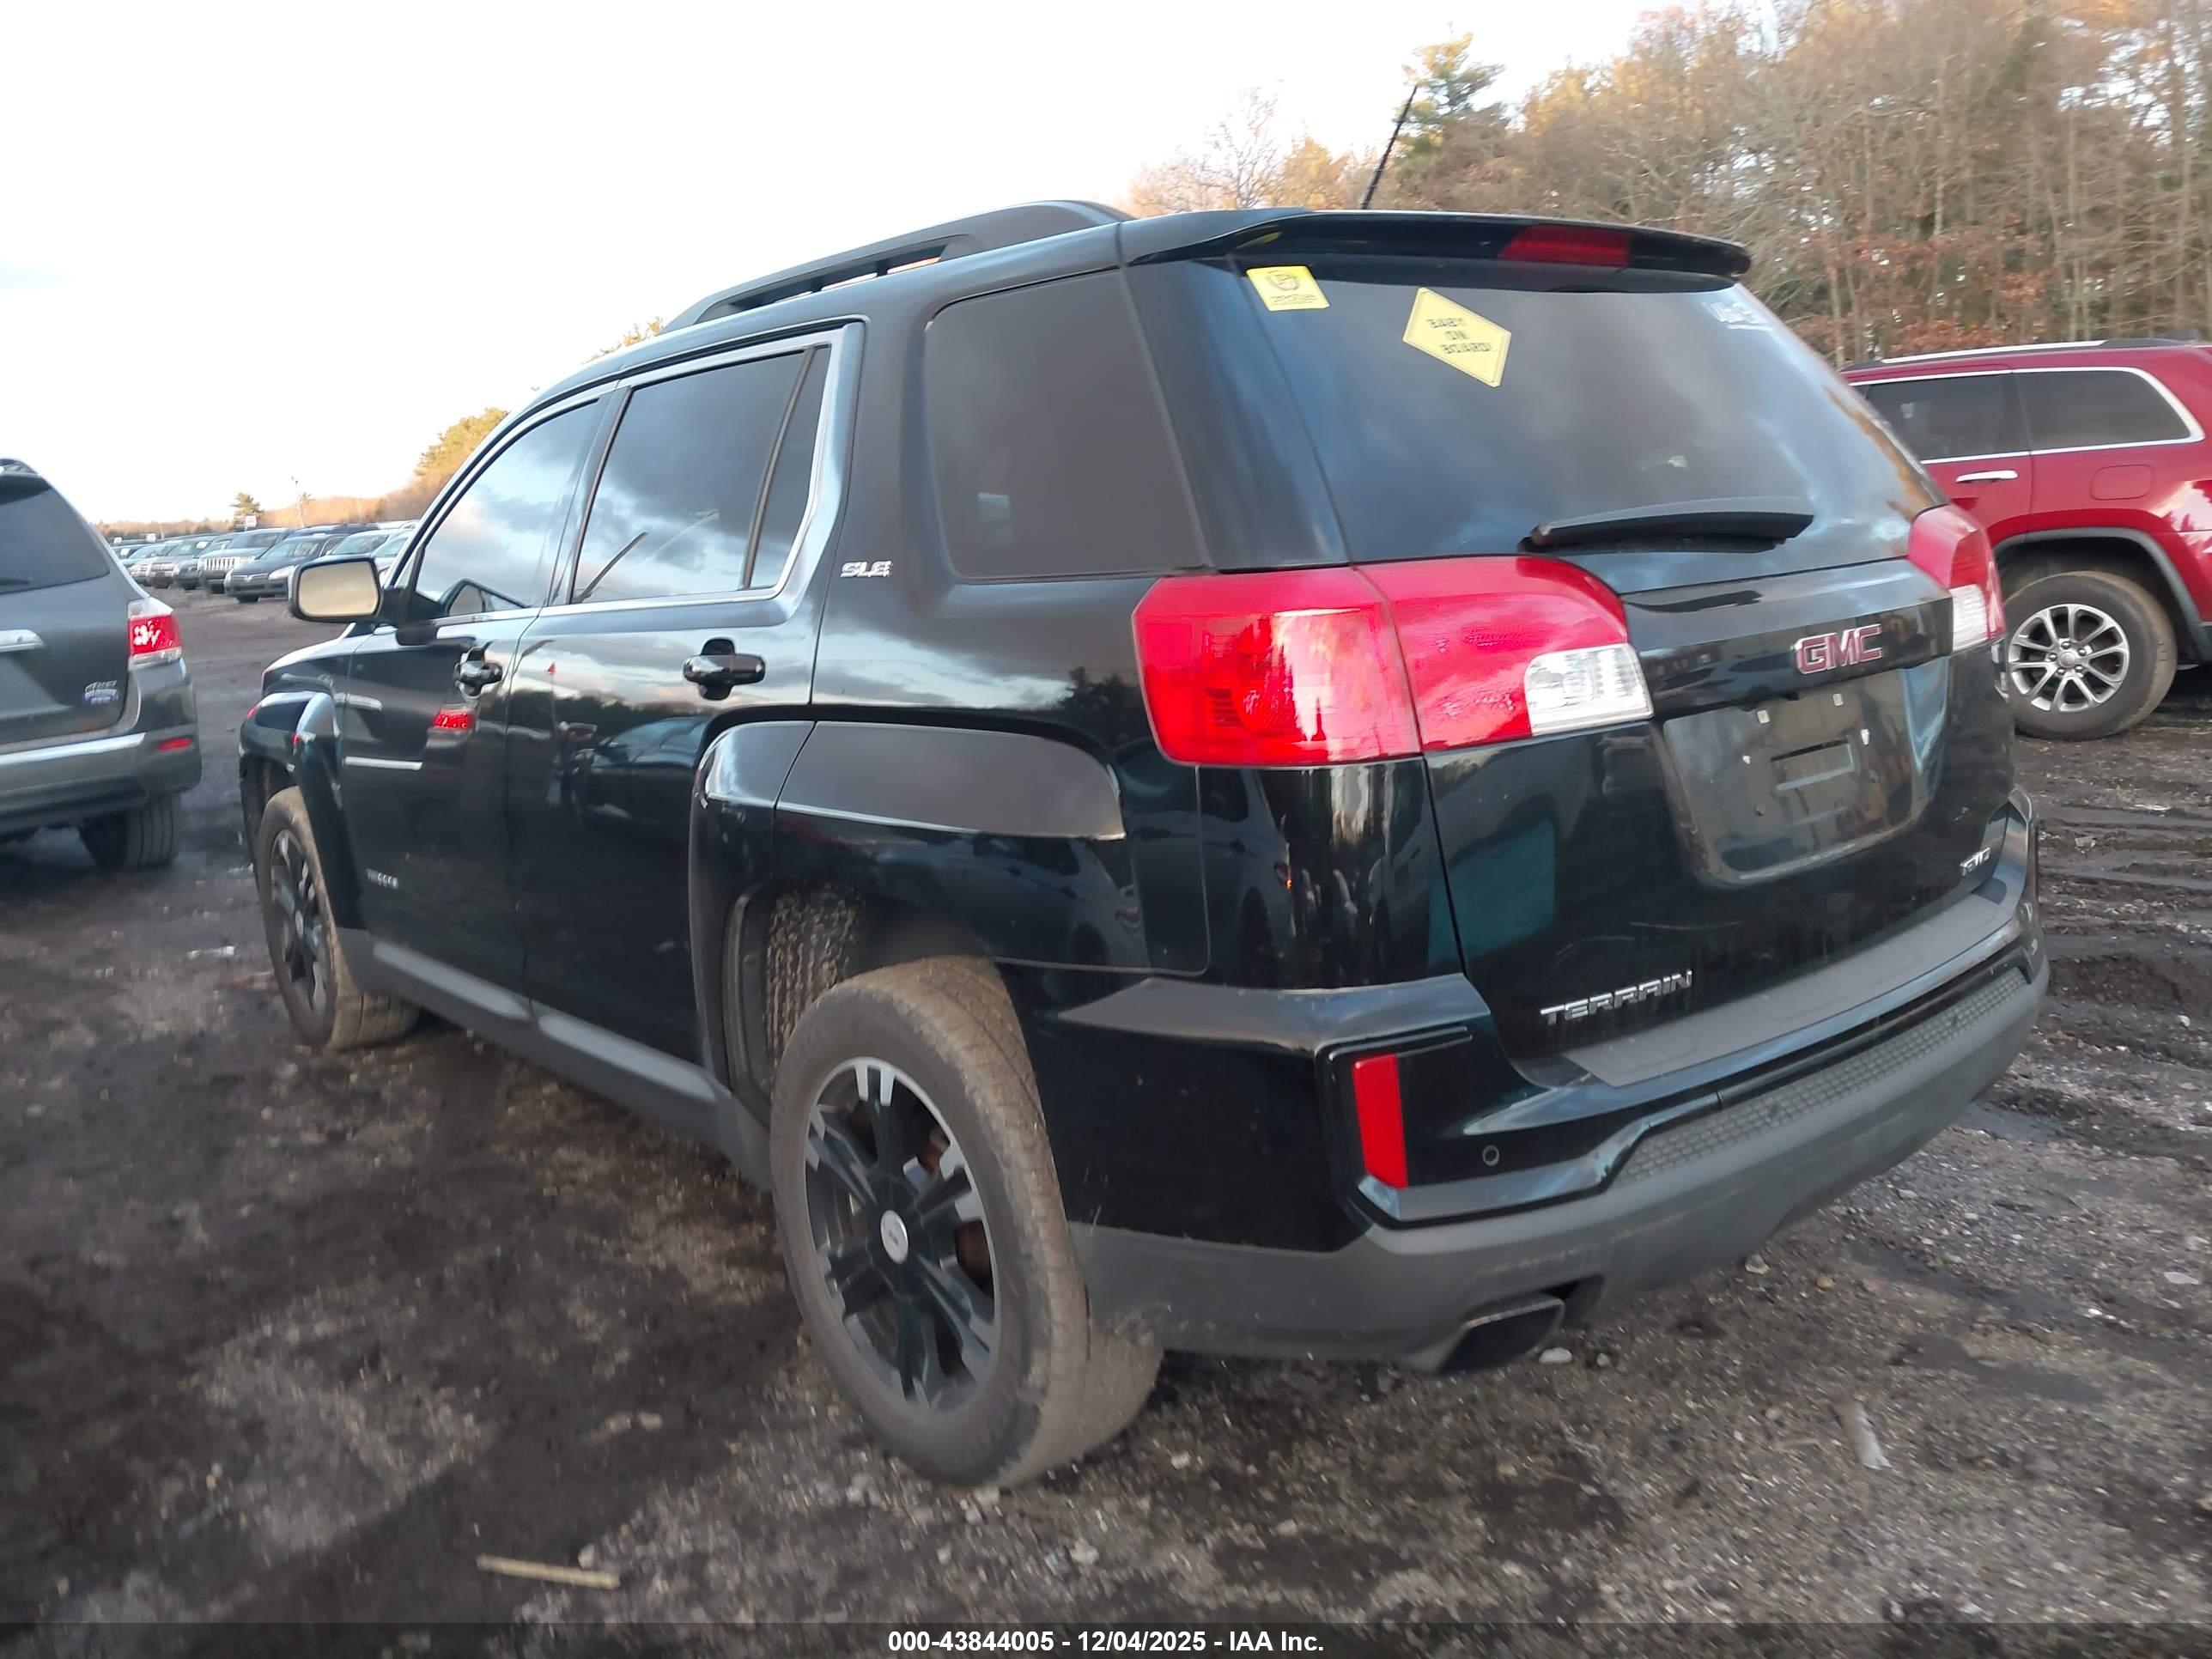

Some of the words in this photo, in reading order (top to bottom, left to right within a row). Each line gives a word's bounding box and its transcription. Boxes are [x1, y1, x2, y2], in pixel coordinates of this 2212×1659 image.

[840, 560, 892, 577] SLE
[1790, 623, 1883, 674] GMC
[1540, 969, 1693, 1025] TERRAIN
